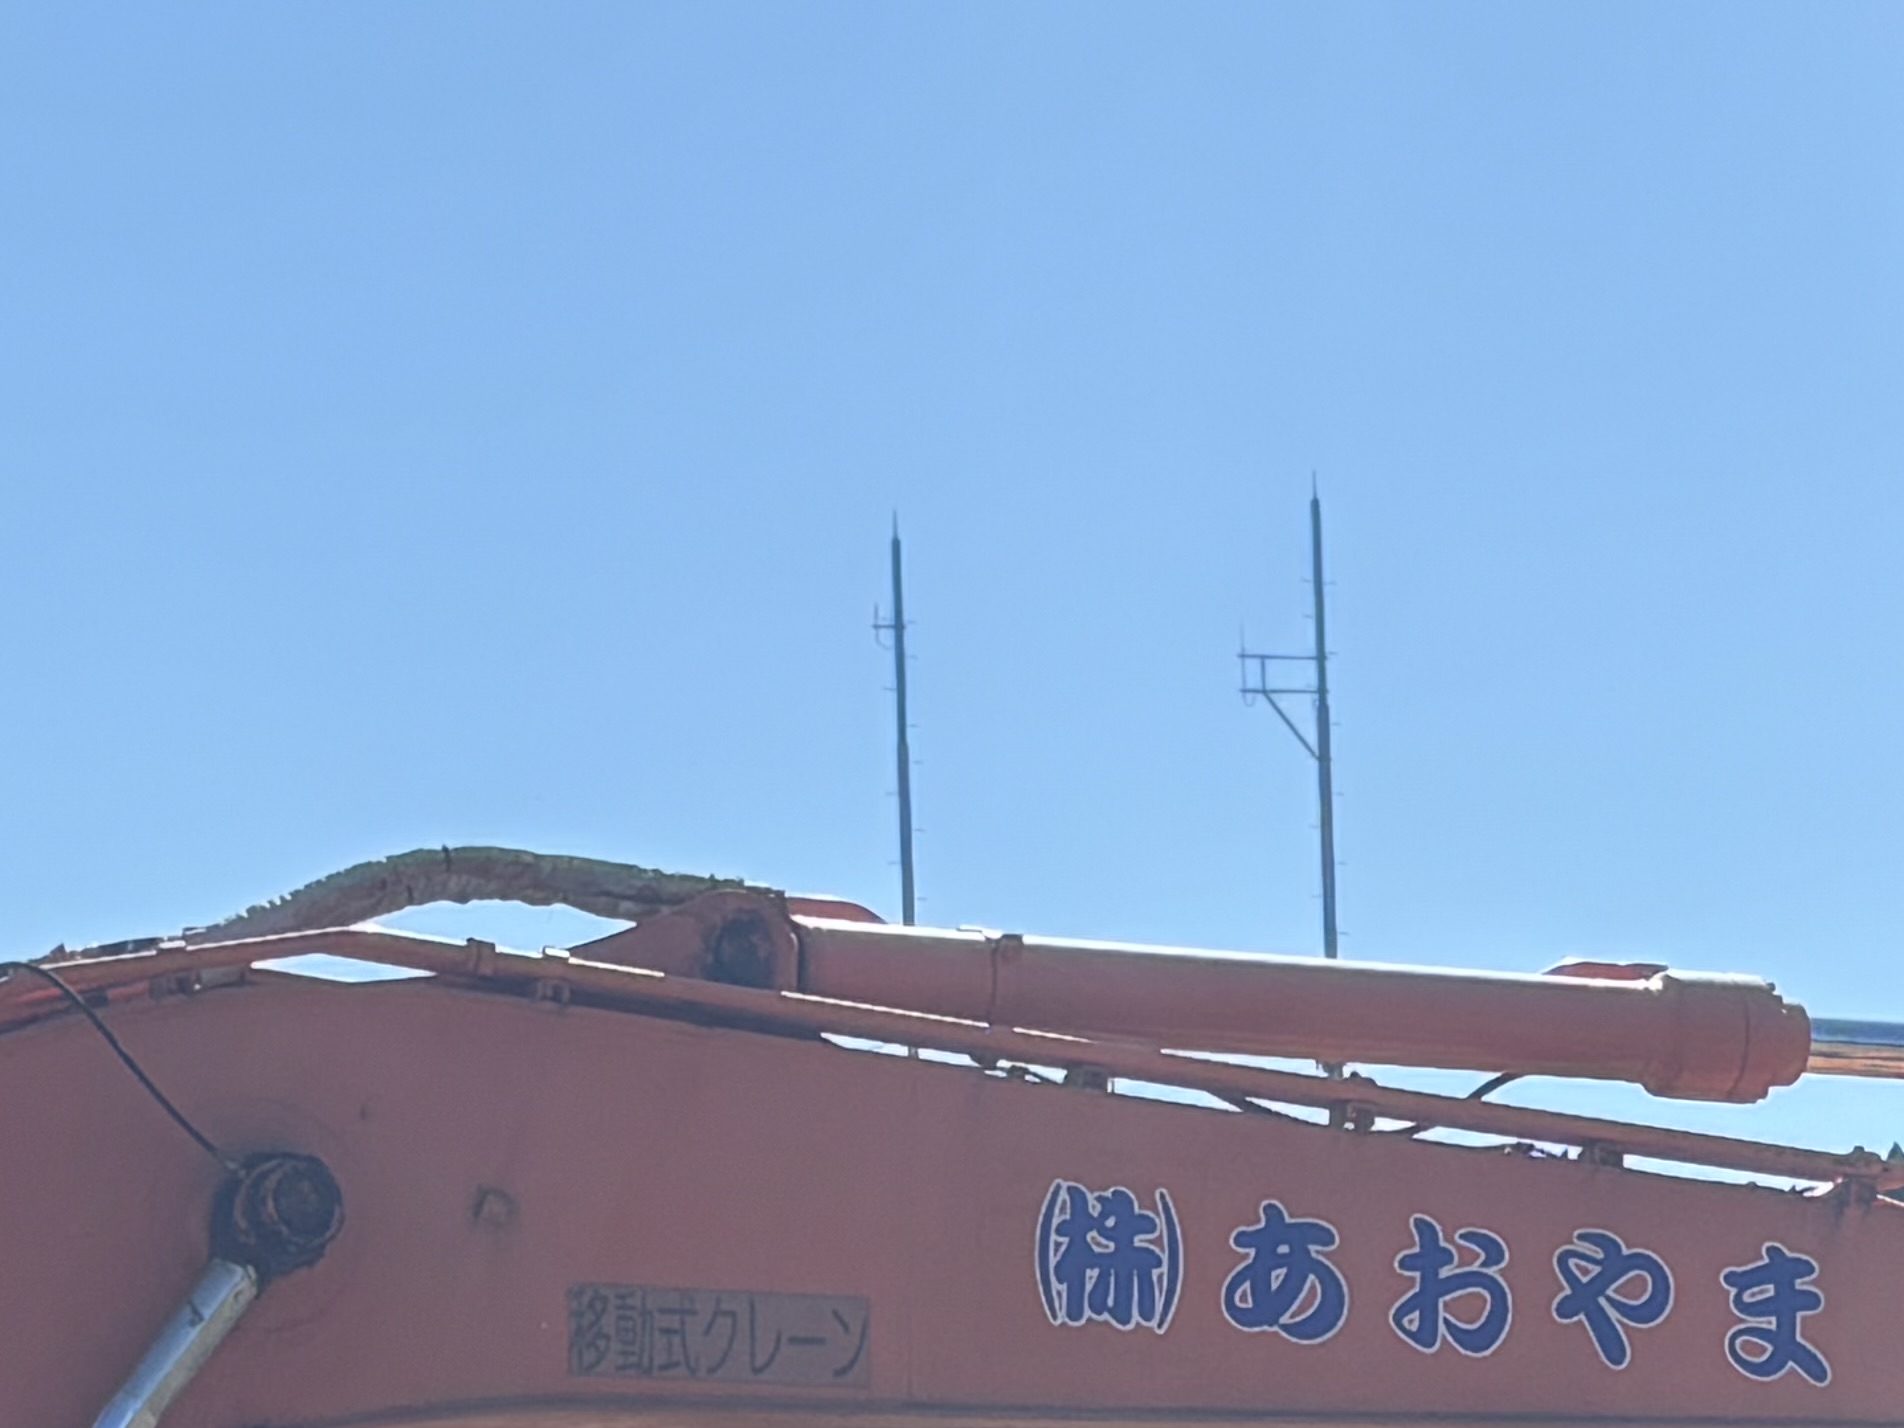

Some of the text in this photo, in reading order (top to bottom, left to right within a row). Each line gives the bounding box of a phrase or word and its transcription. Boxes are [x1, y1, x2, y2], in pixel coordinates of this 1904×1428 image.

[568, 1284, 868, 1378] 移動式クレーン
